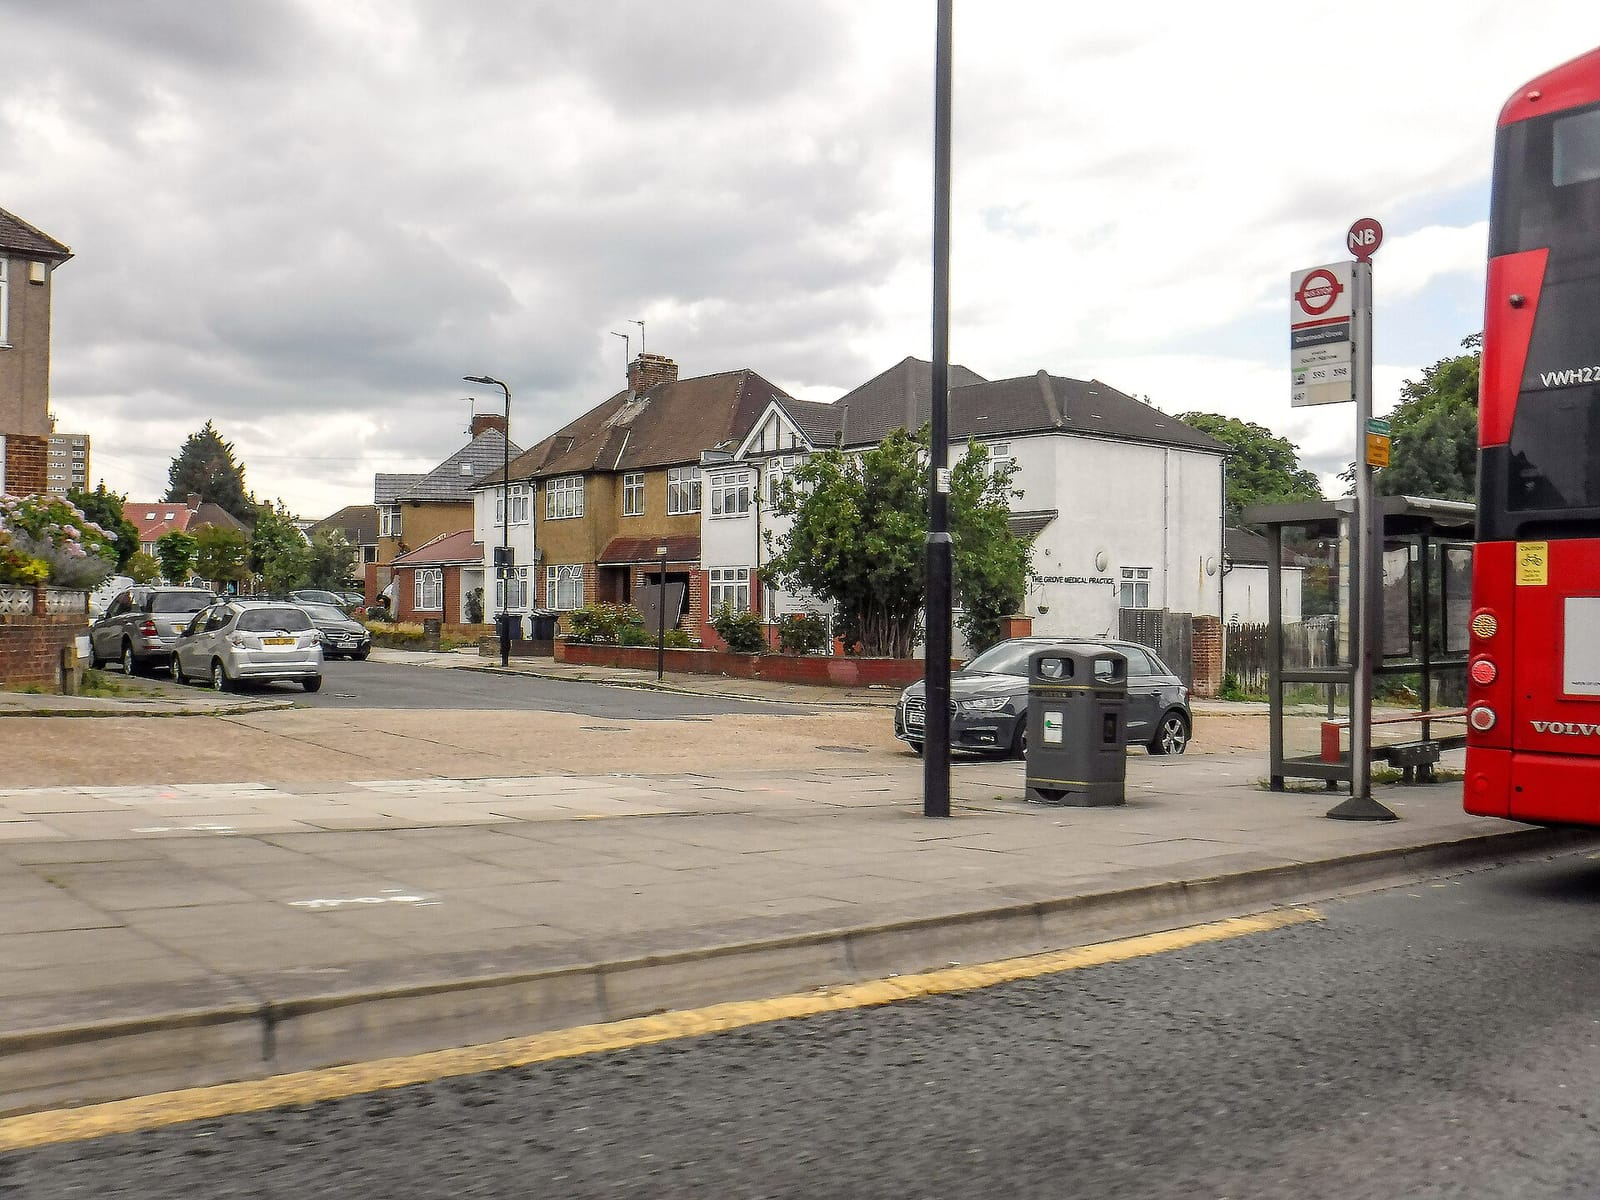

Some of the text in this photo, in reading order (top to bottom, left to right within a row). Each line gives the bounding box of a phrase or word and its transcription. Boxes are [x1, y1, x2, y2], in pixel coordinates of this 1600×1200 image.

[1349, 229, 1375, 248] NB
[1540, 366, 1600, 387] VWH22
[1089, 577, 1115, 585] PRACTICE
[1530, 721, 1600, 736] VOLV
